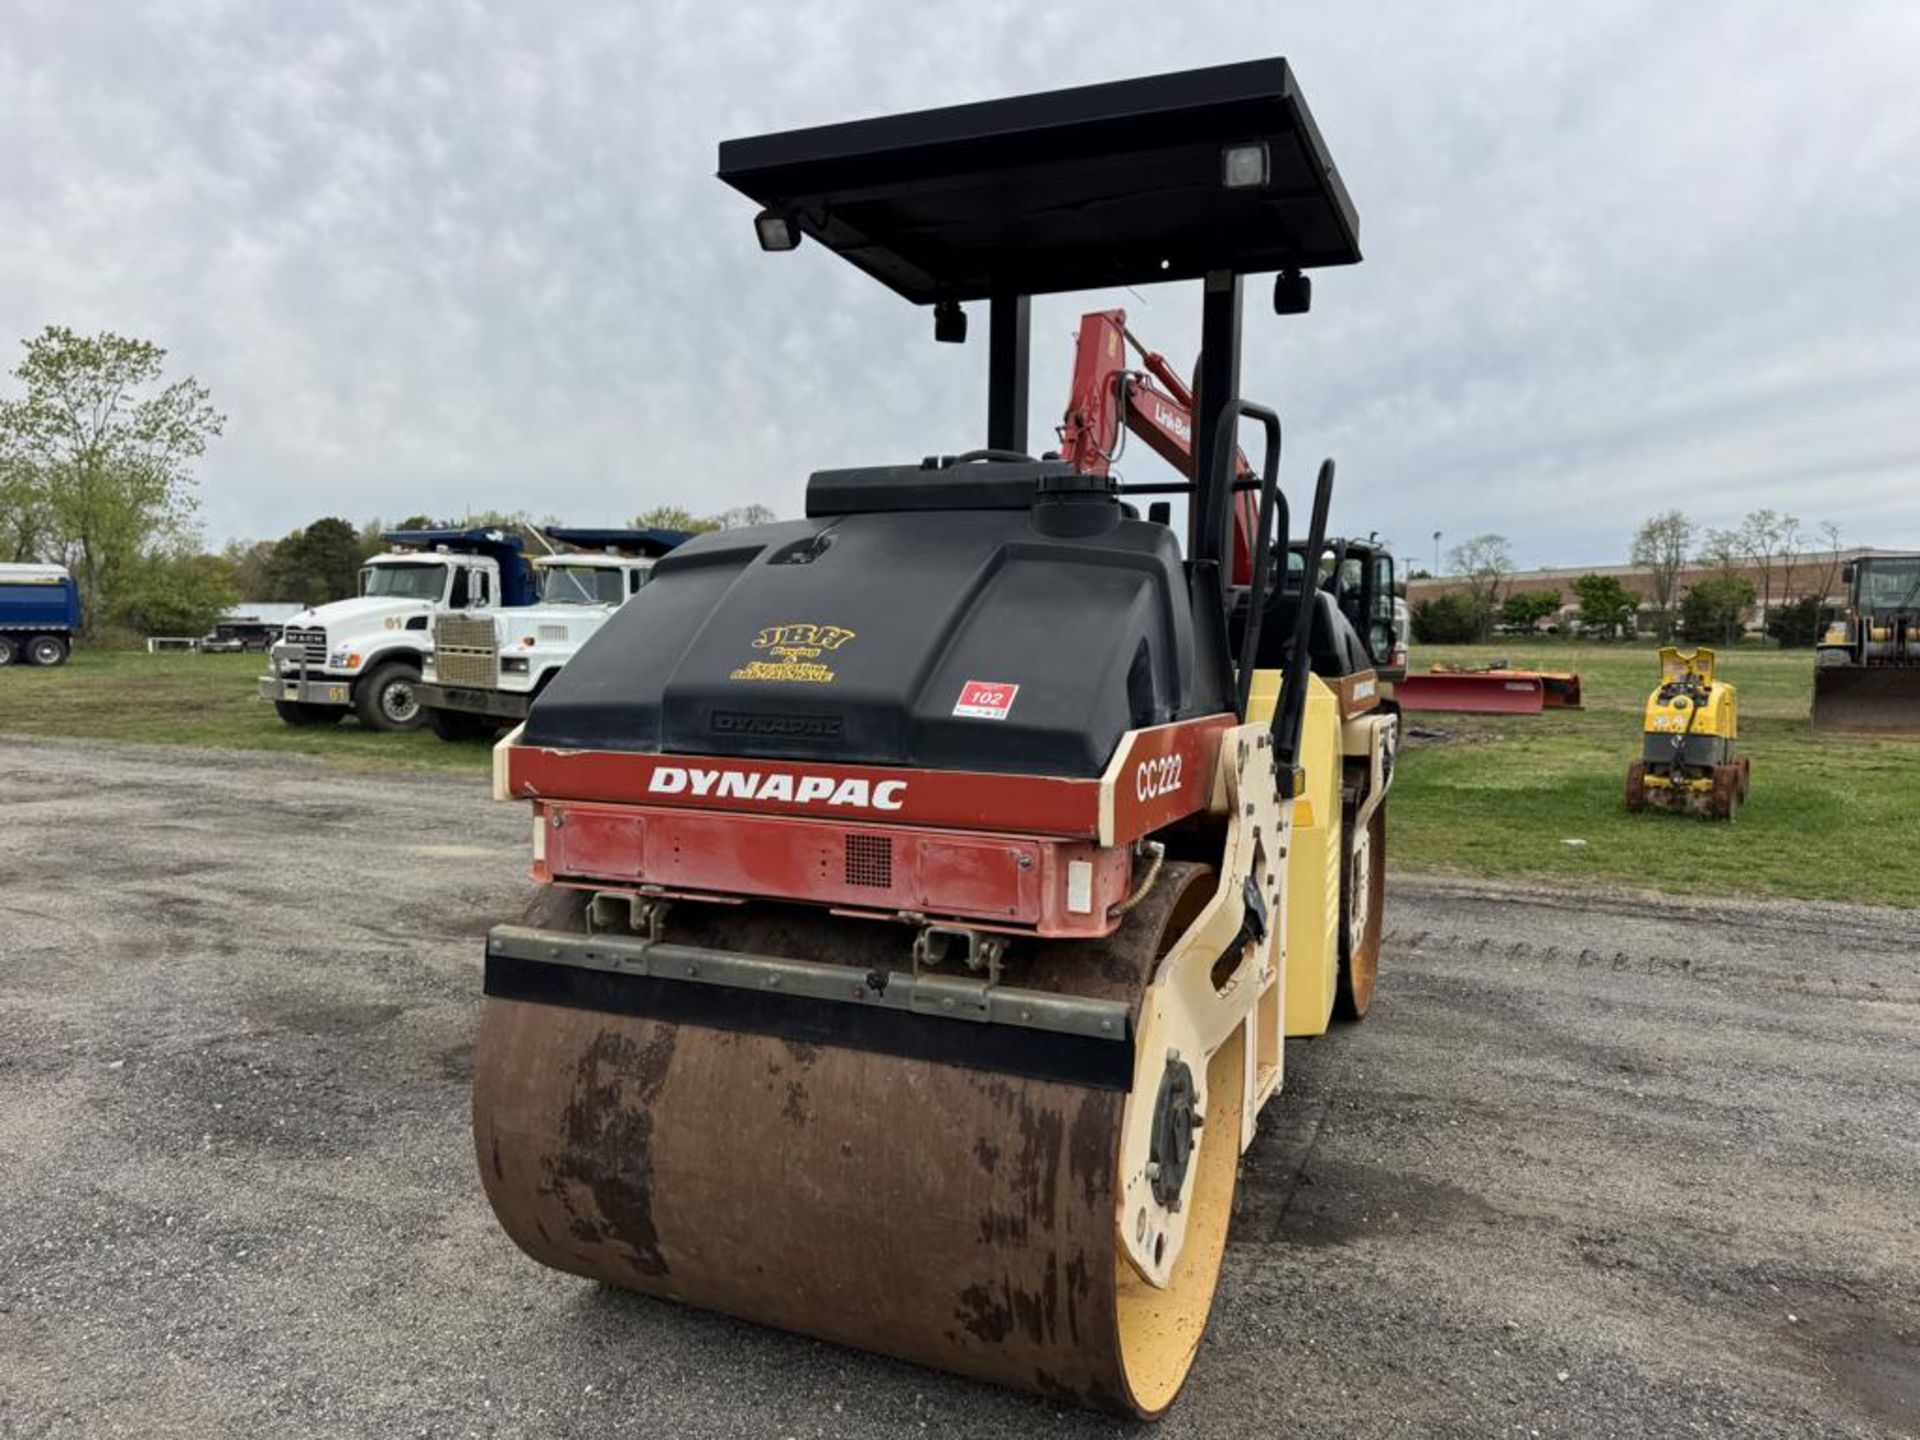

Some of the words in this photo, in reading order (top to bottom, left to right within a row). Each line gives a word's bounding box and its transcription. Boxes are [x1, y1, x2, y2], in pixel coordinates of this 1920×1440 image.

[1154, 402, 1191, 443] Link-Bel
[971, 691, 1004, 706] 102
[648, 766, 908, 810] DYNAPAC
[1136, 752, 1182, 802] CC222
